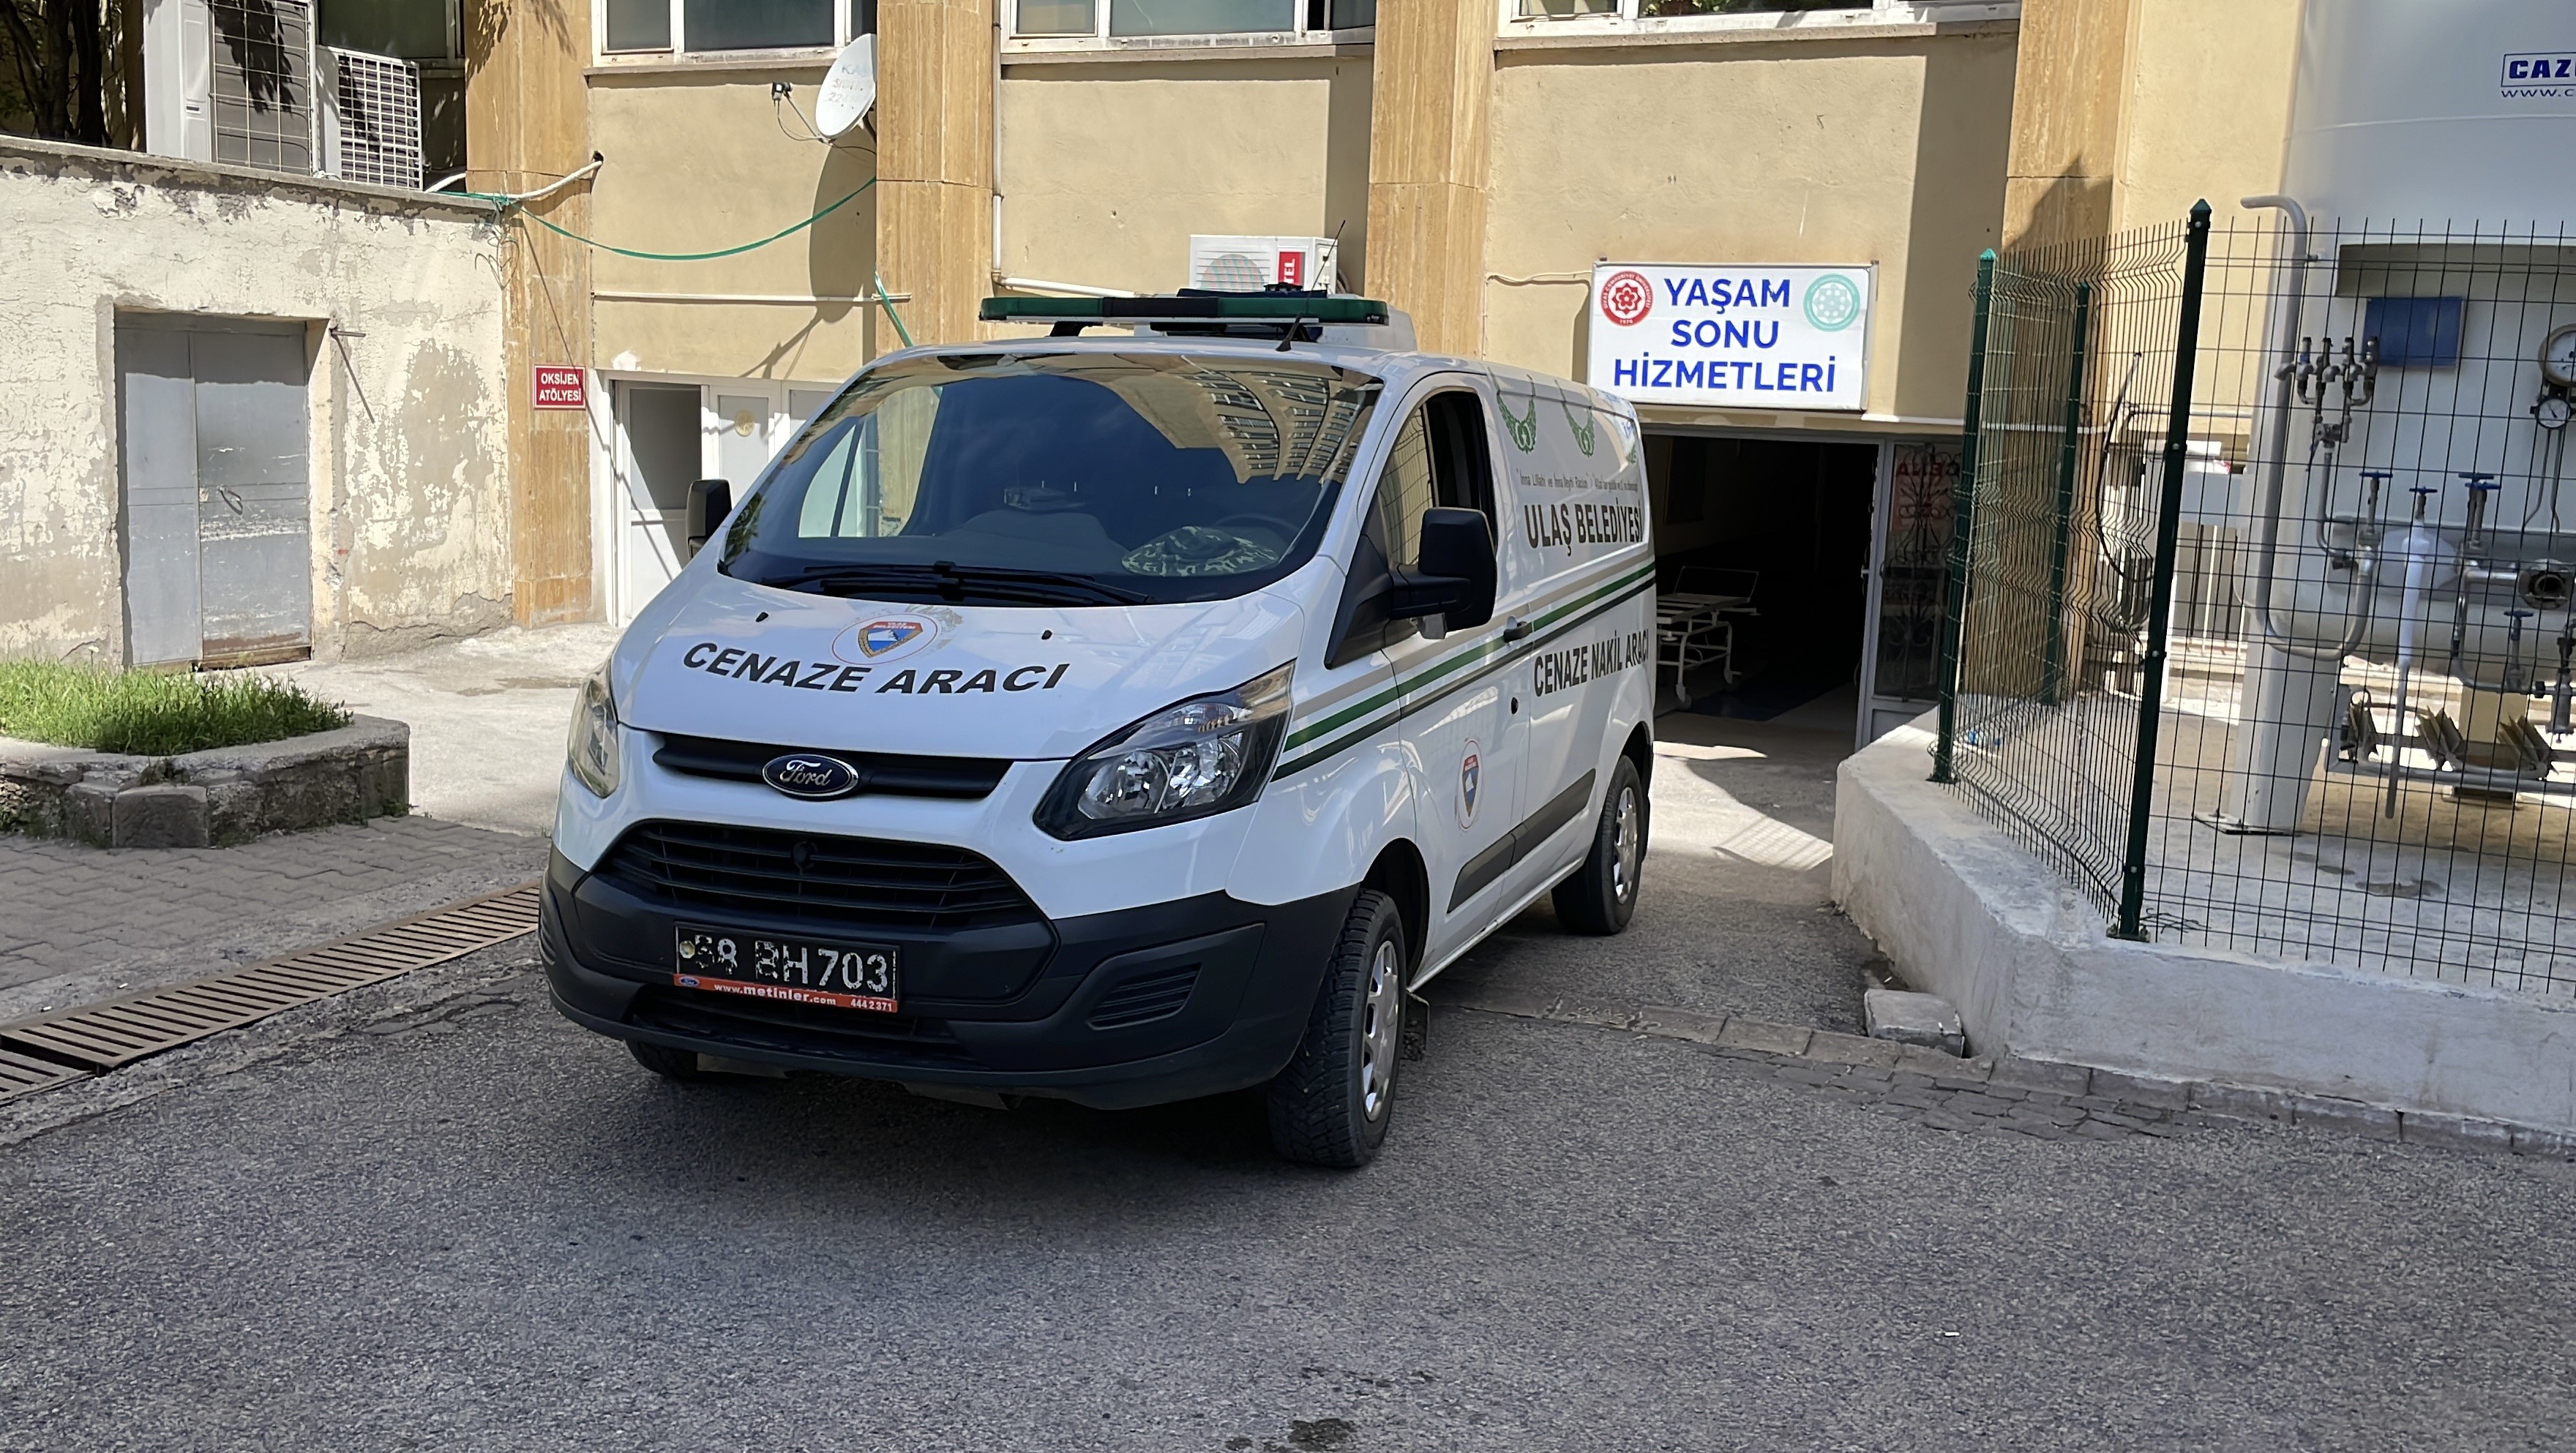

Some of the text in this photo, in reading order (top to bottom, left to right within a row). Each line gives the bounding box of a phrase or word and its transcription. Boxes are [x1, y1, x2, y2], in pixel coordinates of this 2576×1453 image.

[2509, 59, 2576, 79] CAZ
[1663, 278, 1790, 315] YAŞAM
[1671, 320, 1779, 349] SONU
[541, 371, 580, 385] OKSİJEN
[1614, 351, 1835, 392] HİZMETLERİ
[539, 388, 582, 402] ATÖLYESİ
[1524, 498, 1643, 557] ULAŞ BELEDİYESİ
[683, 642, 1070, 694] CENAZE ARACI
[1534, 628, 1649, 697] CENAZE NAKİL ARACI
[779, 759, 832, 787] Ford
[817, 947, 888, 993] 703
[714, 984, 836, 1005] www.metinler.com
